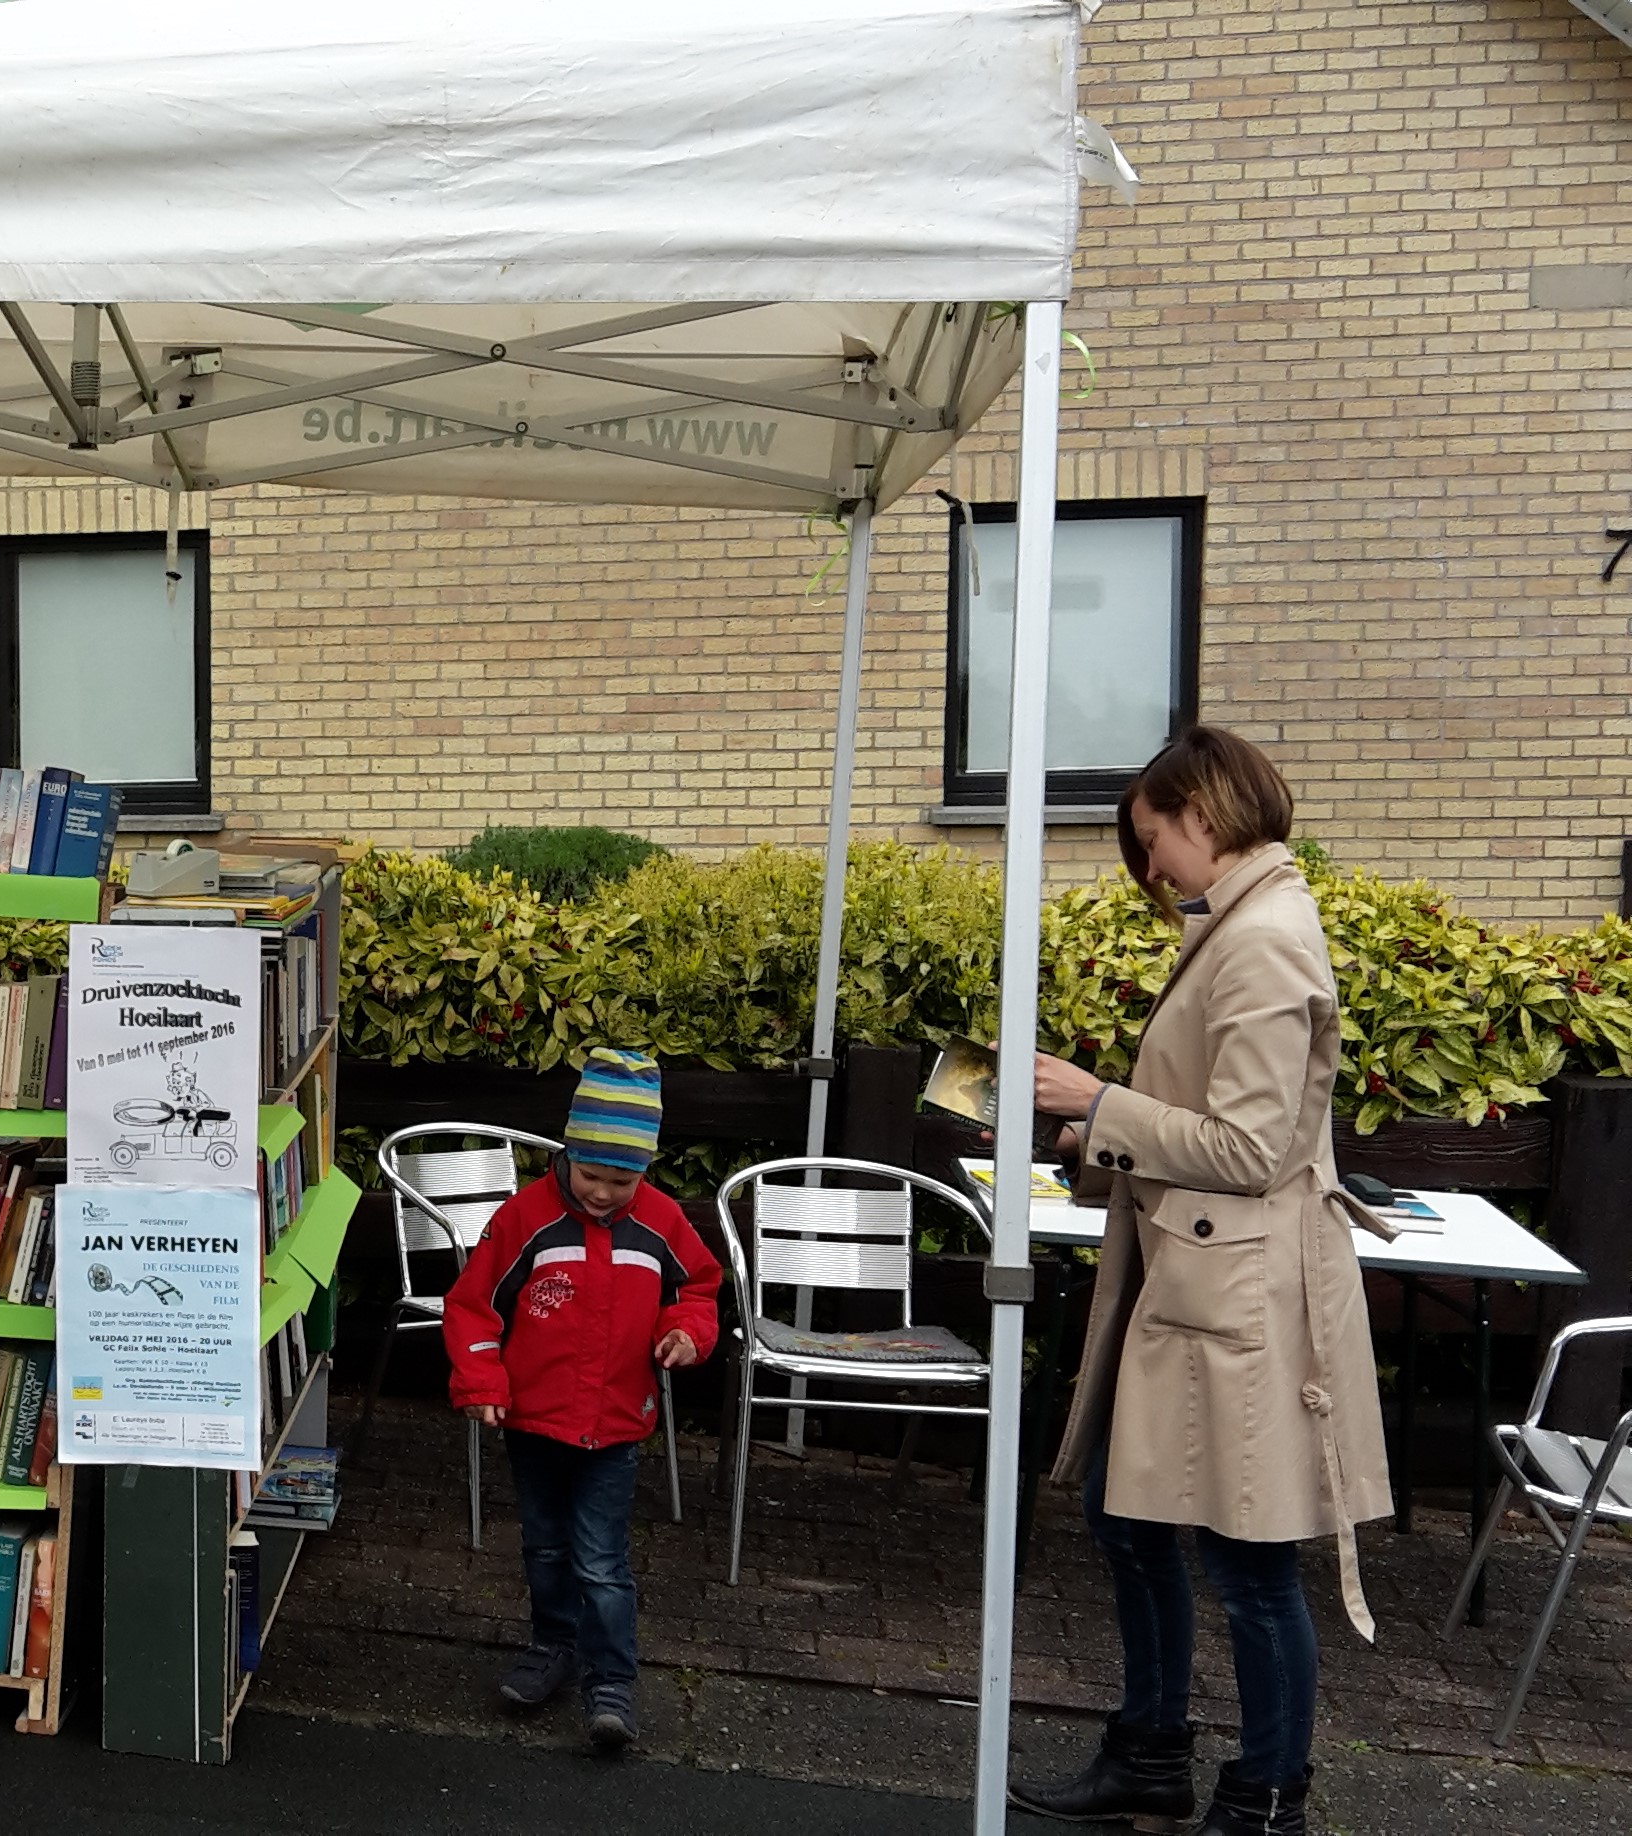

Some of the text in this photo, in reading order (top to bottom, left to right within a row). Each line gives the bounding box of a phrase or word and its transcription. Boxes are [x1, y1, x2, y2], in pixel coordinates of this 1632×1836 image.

[42, 781, 68, 798] EURO
[81, 979, 243, 1009] Druivenzoektocht
[119, 1006, 204, 1028] Hoeilaart
[76, 1021, 236, 1073] Van 8 mei tot 11 september 2016
[81, 1235, 239, 1254] JAN VERHEYEN
[142, 1262, 240, 1274] DE GESCHIEDENIS
[200, 1280, 240, 1290] VAN DE
[213, 1296, 240, 1306] FILM
[88, 1335, 130, 1343] VRIJDAG
[132, 1335, 143, 1343] 27
[145, 1335, 163, 1343] MEI
[166, 1336, 189, 1344] 2016
[199, 1337, 211, 1345] 20
[213, 1338, 233, 1346] UUR
[177, 1346, 219, 1355] Hoeilaart
